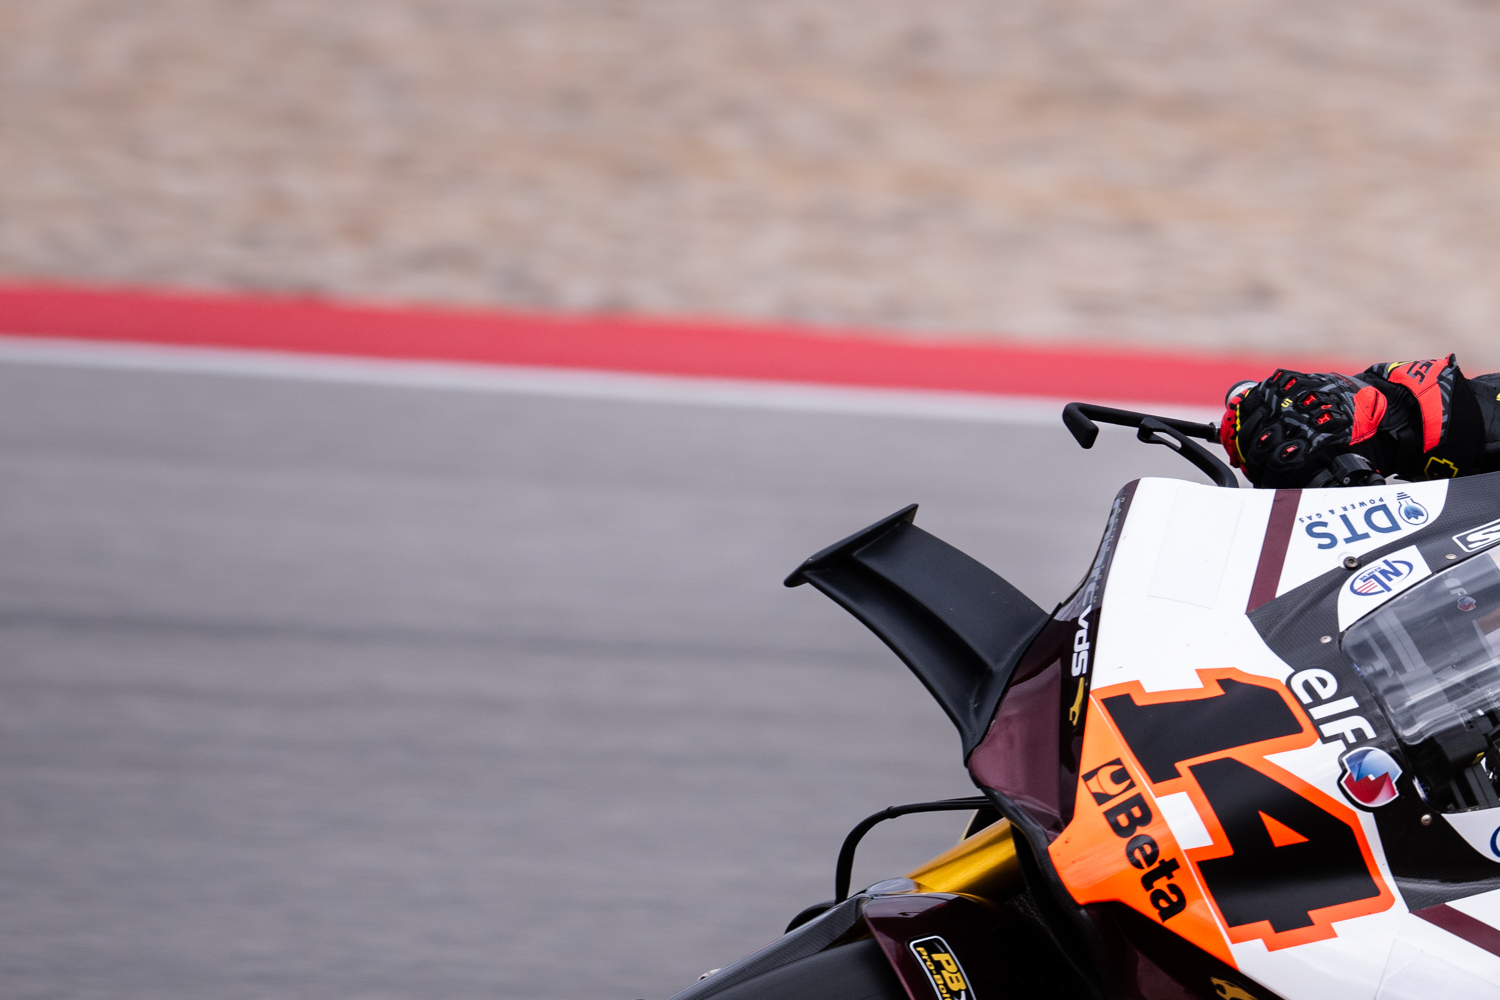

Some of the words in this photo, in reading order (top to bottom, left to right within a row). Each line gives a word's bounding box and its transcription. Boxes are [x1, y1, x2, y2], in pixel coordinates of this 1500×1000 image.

[1299, 512, 1323, 524] GAS
[1341, 496, 1384, 513] POWER
[1305, 504, 1402, 550] DTS
[1362, 558, 1404, 593] NL
[1288, 668, 1377, 745] elf
[1098, 676, 1383, 937] 14
[1102, 792, 1188, 924] Beta
[930, 952, 968, 992] PB
